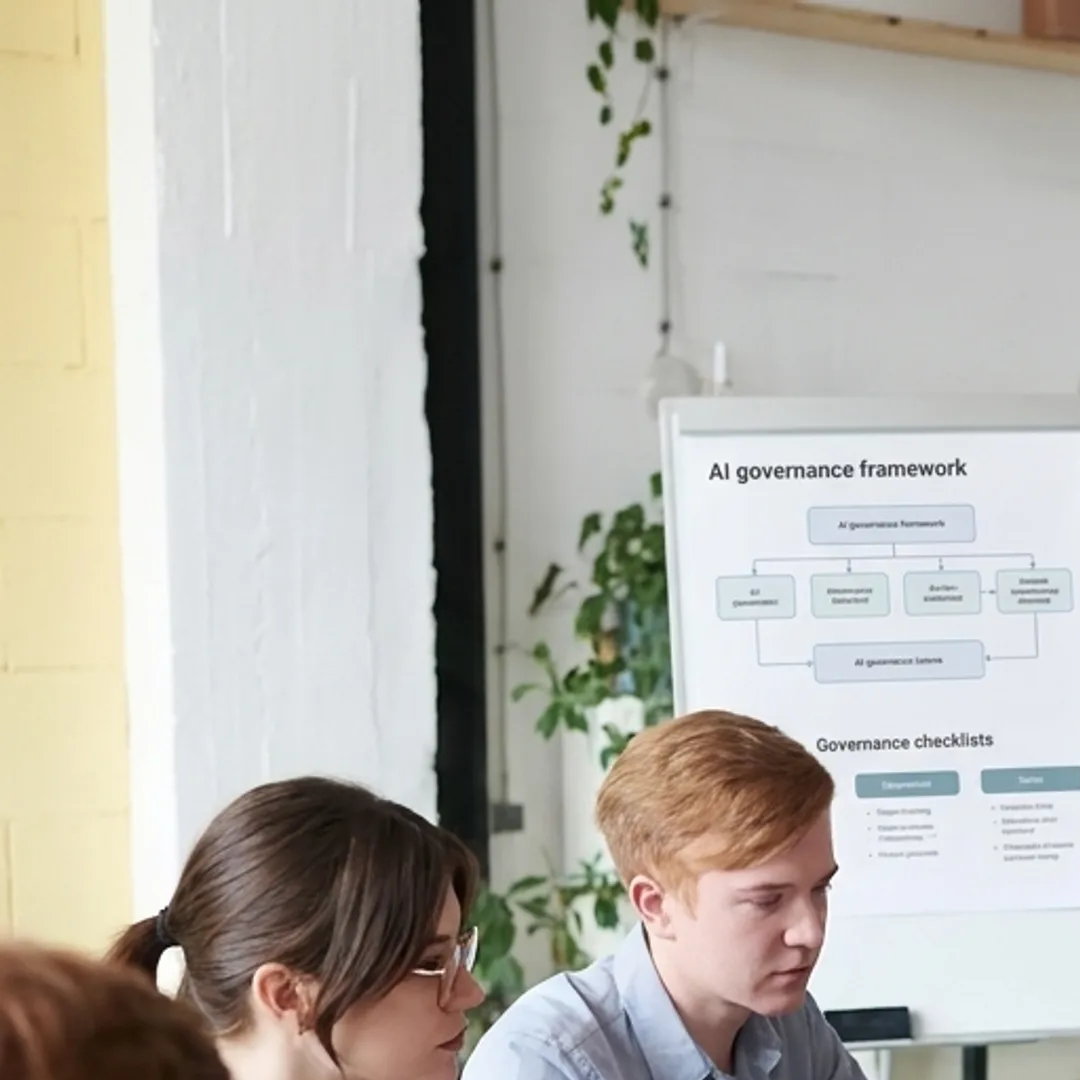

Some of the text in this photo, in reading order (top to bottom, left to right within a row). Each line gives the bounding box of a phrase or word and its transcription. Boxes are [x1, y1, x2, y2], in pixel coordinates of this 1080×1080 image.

[708, 458, 967, 484] AI governance framework
[816, 732, 994, 752] Governance checklists
